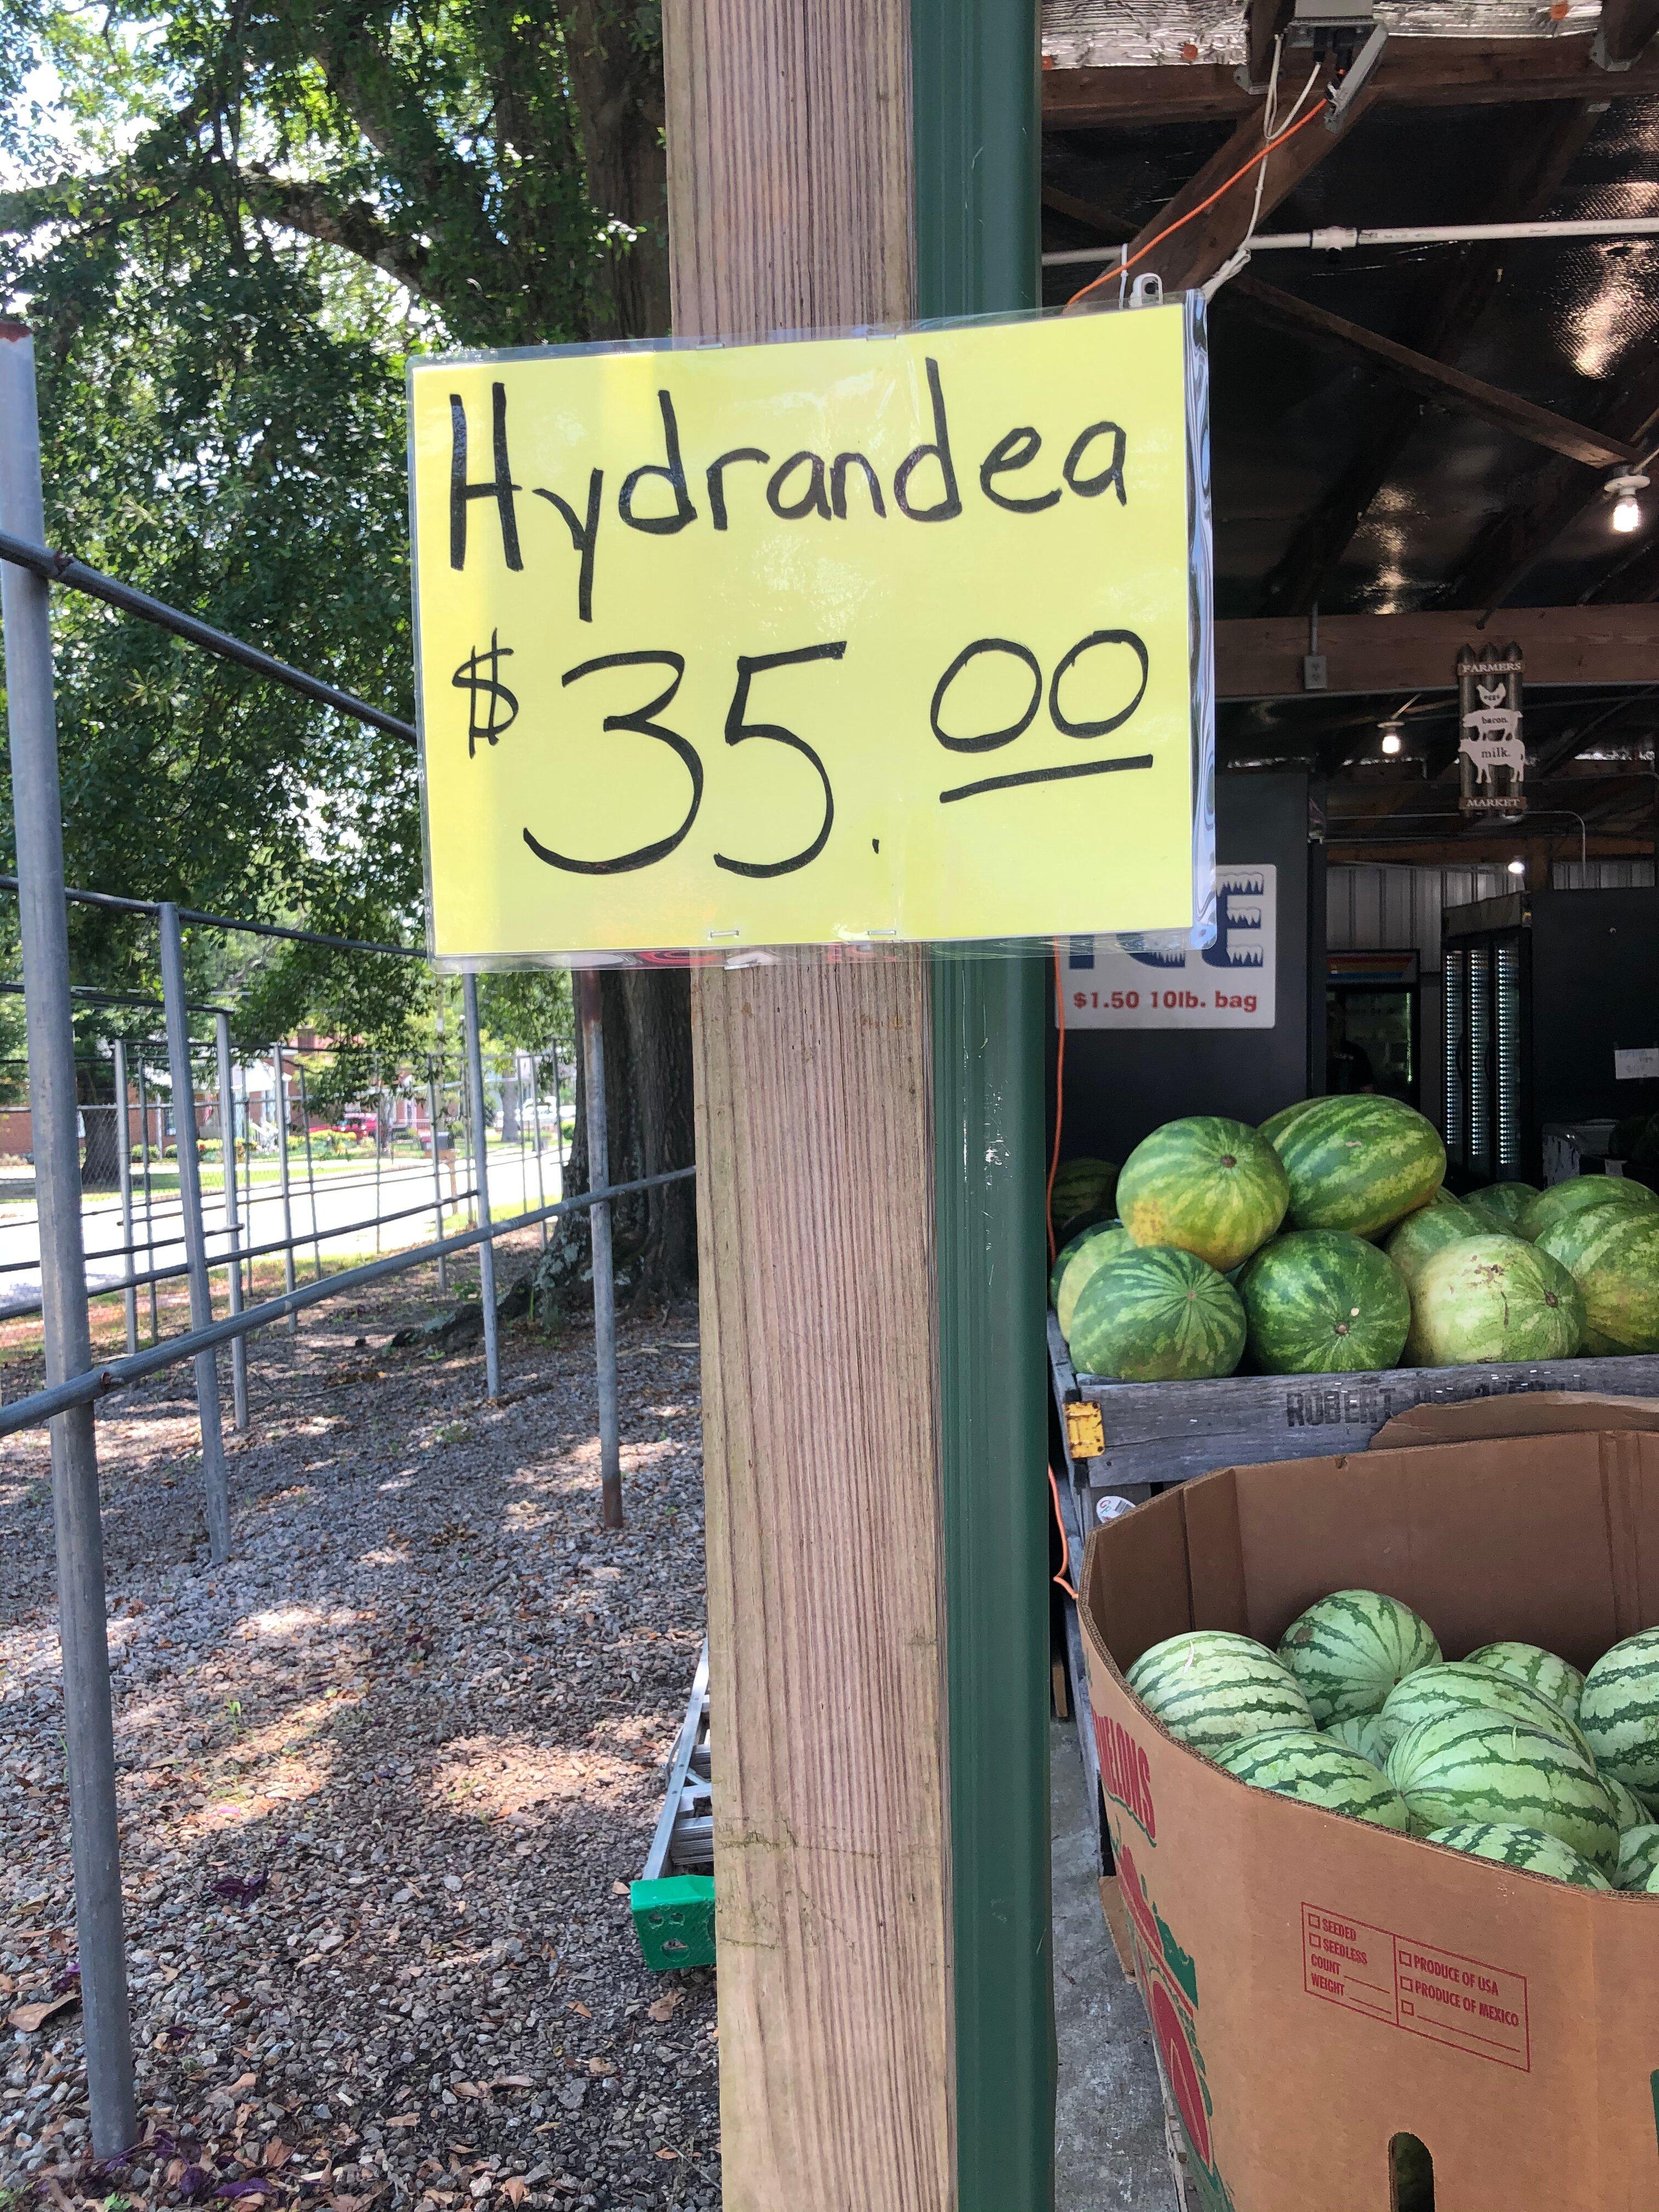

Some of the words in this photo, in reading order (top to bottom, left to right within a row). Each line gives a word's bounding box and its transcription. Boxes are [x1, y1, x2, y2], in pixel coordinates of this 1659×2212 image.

[449, 357, 1128, 622] Hydrandea
[1462, 663, 1521, 673] FARMERS
[1481, 746, 1510, 759] milk.
[1466, 798, 1521, 808] MARKET
[1074, 990, 1141, 1009] $1.50
[1152, 990, 1206, 1009] 10lb.
[1215, 990, 1257, 1013] bag
[1322, 1918, 1357, 1942] SEEDED
[1323, 1938, 1368, 1965] SEEDLESS
[1311, 1953, 1342, 1976] COUNT
[1414, 1954, 1459, 1983] PRODUCE
[1462, 1971, 1476, 1988] OF
[1478, 1976, 1499, 1996] USA
[1311, 1972, 1345, 1996] WEIGHT
[1415, 1979, 1460, 2008] PRODUCE
[1463, 1996, 1476, 2013] OF
[1479, 2002, 1520, 2028] MEXICO
